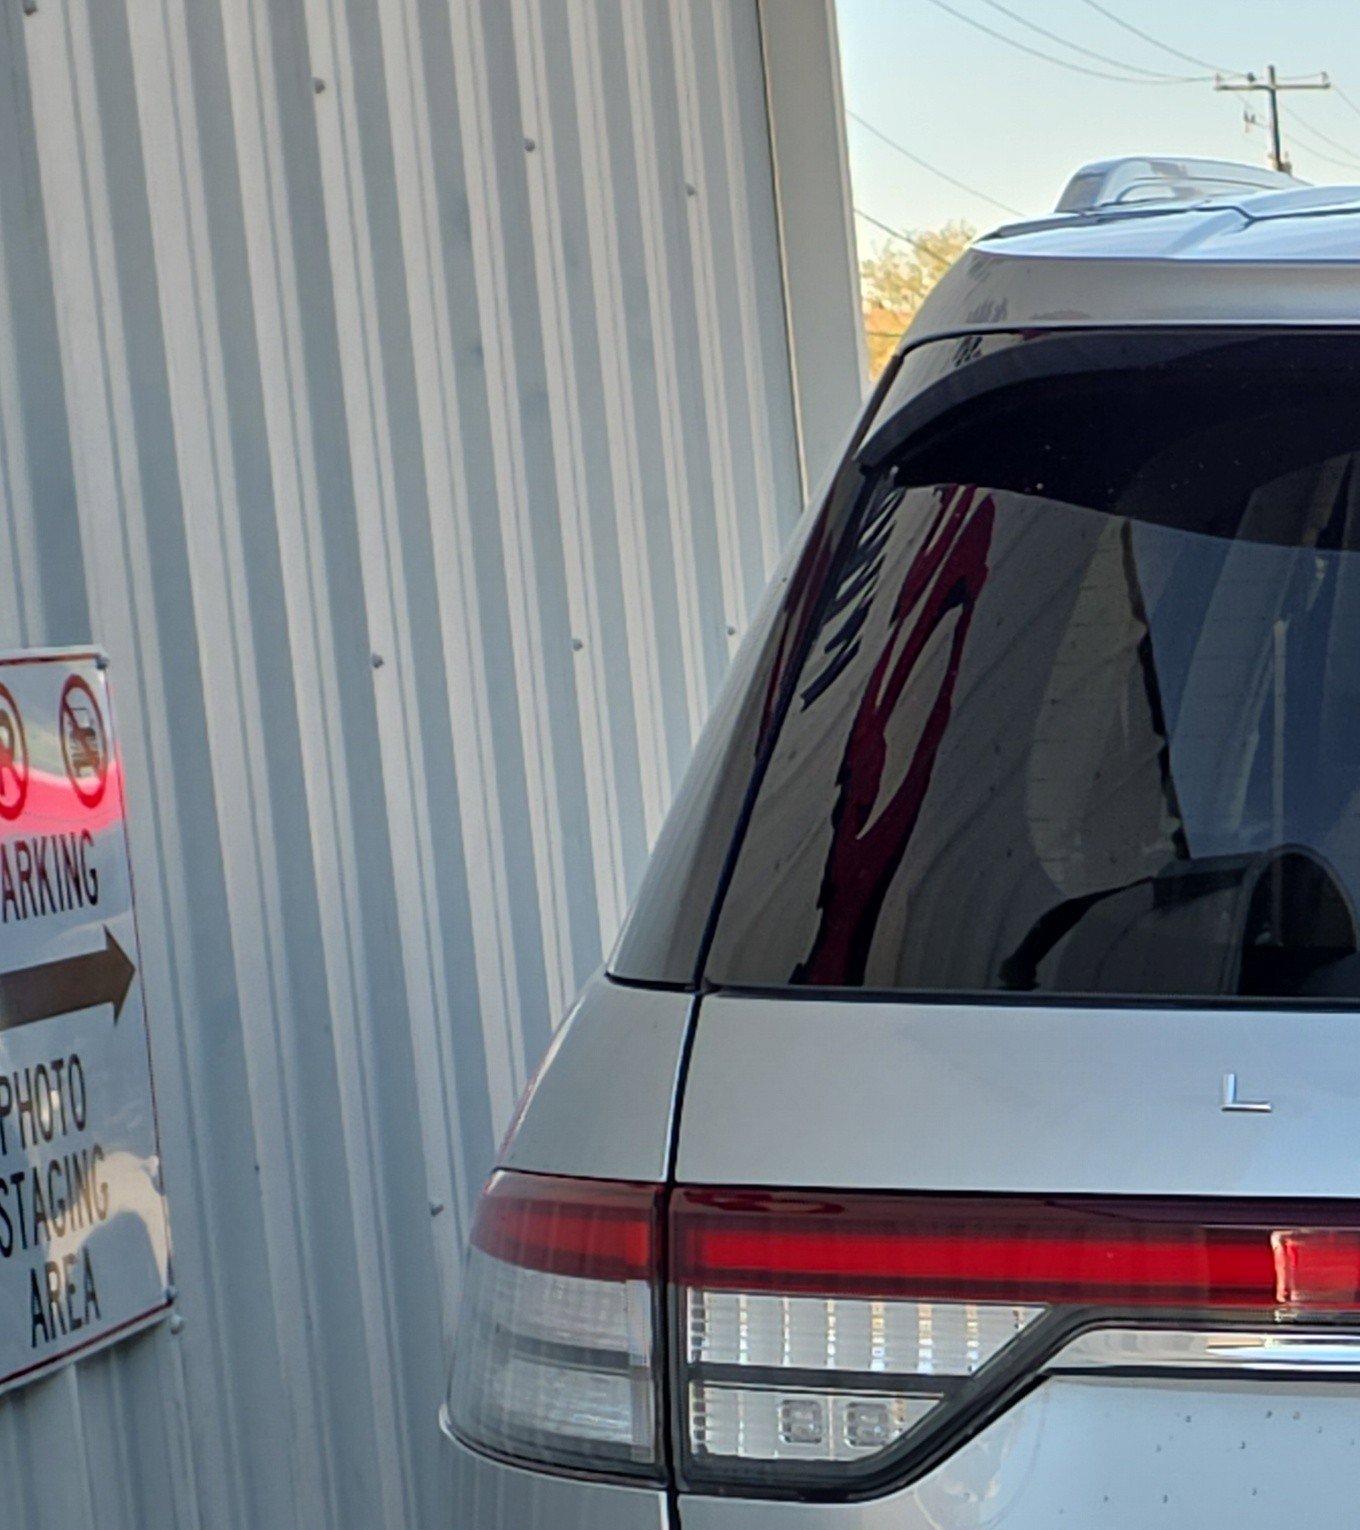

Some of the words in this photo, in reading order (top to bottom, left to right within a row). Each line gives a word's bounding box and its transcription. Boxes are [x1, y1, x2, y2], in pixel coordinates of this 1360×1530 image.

[0, 829, 98, 924] ARKING
[0, 1053, 86, 1156] PHOTO
[0, 1144, 109, 1258] STAGING
[31, 1246, 101, 1348] AREA
